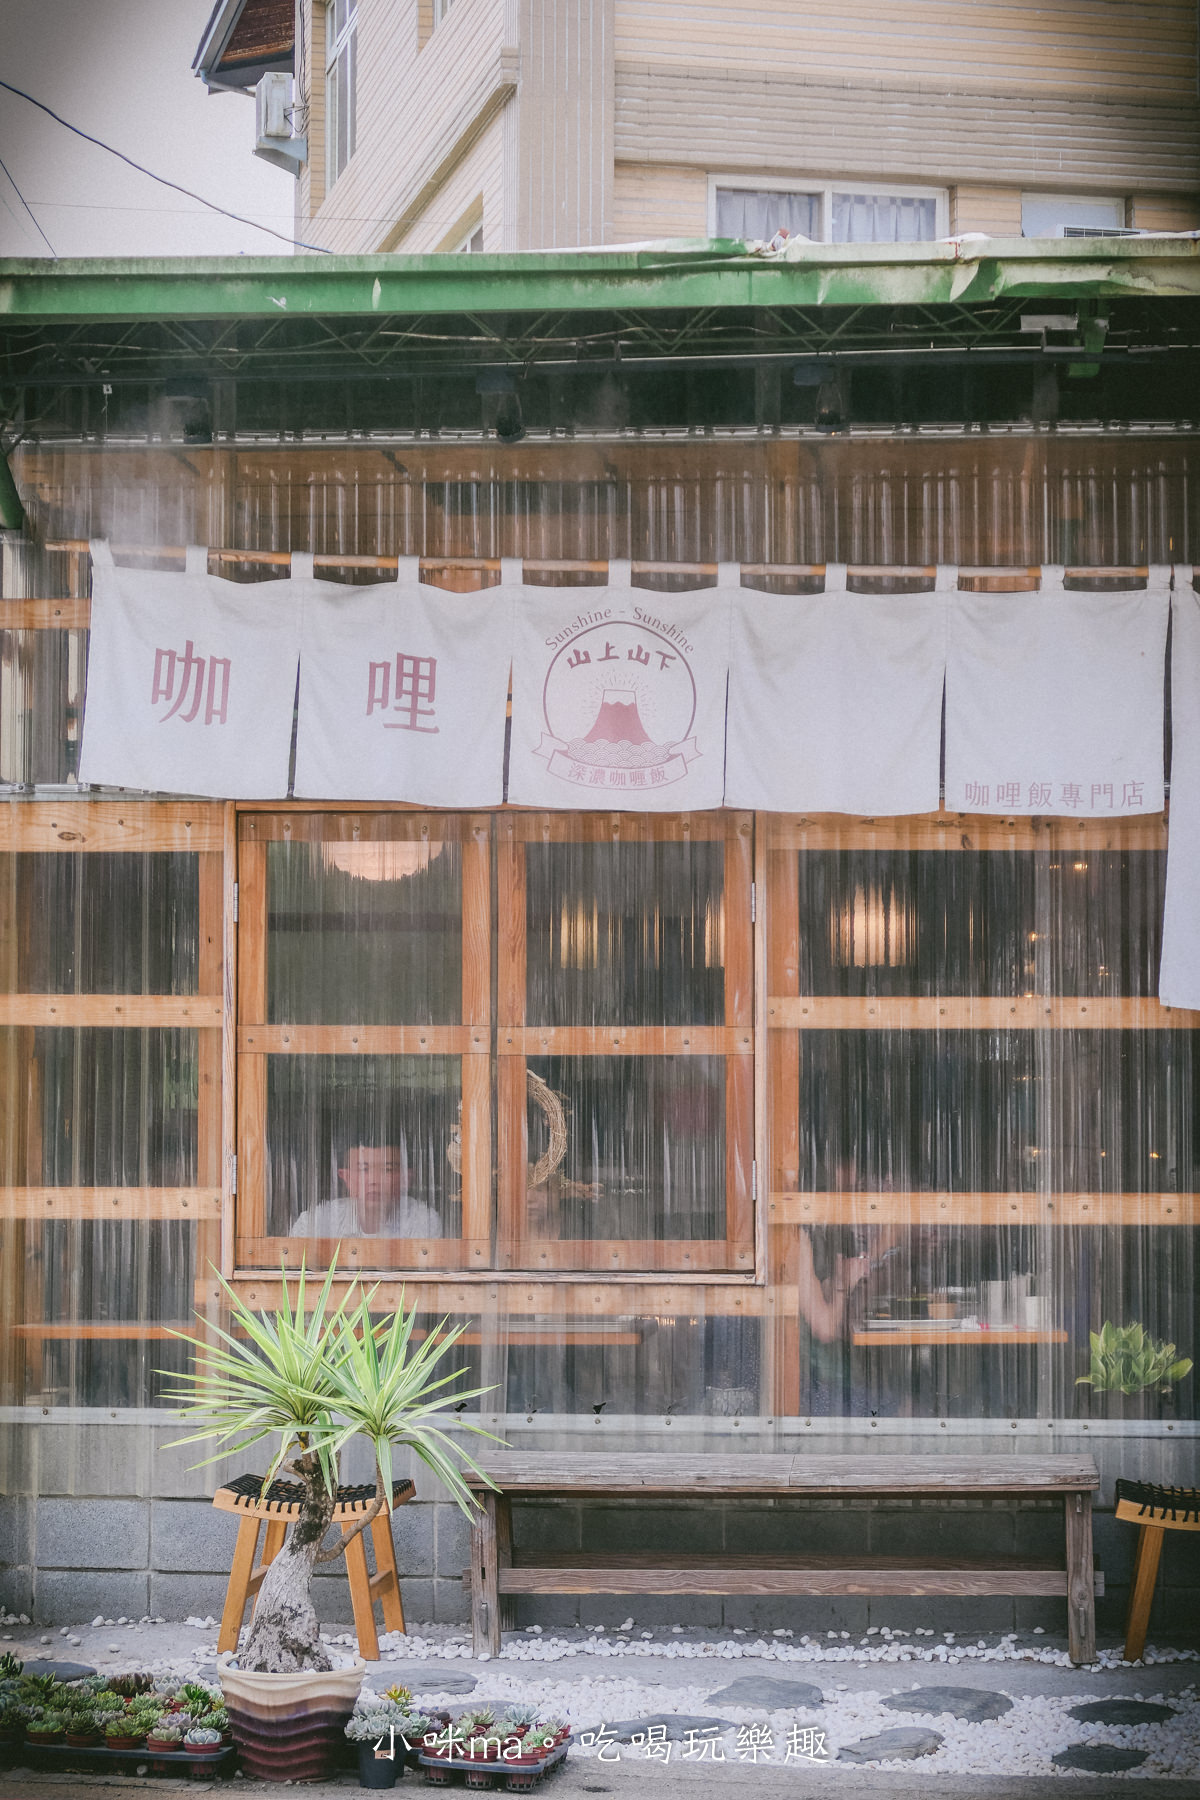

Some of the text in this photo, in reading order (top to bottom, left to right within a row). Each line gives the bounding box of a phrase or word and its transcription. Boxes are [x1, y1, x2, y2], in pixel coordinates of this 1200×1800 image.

[545, 607, 612, 651] Sunshine
[632, 606, 694, 654] Sunshine
[567, 641, 676, 670] 山上山下
[964, 780, 1146, 809] 咖哩飯專門店
